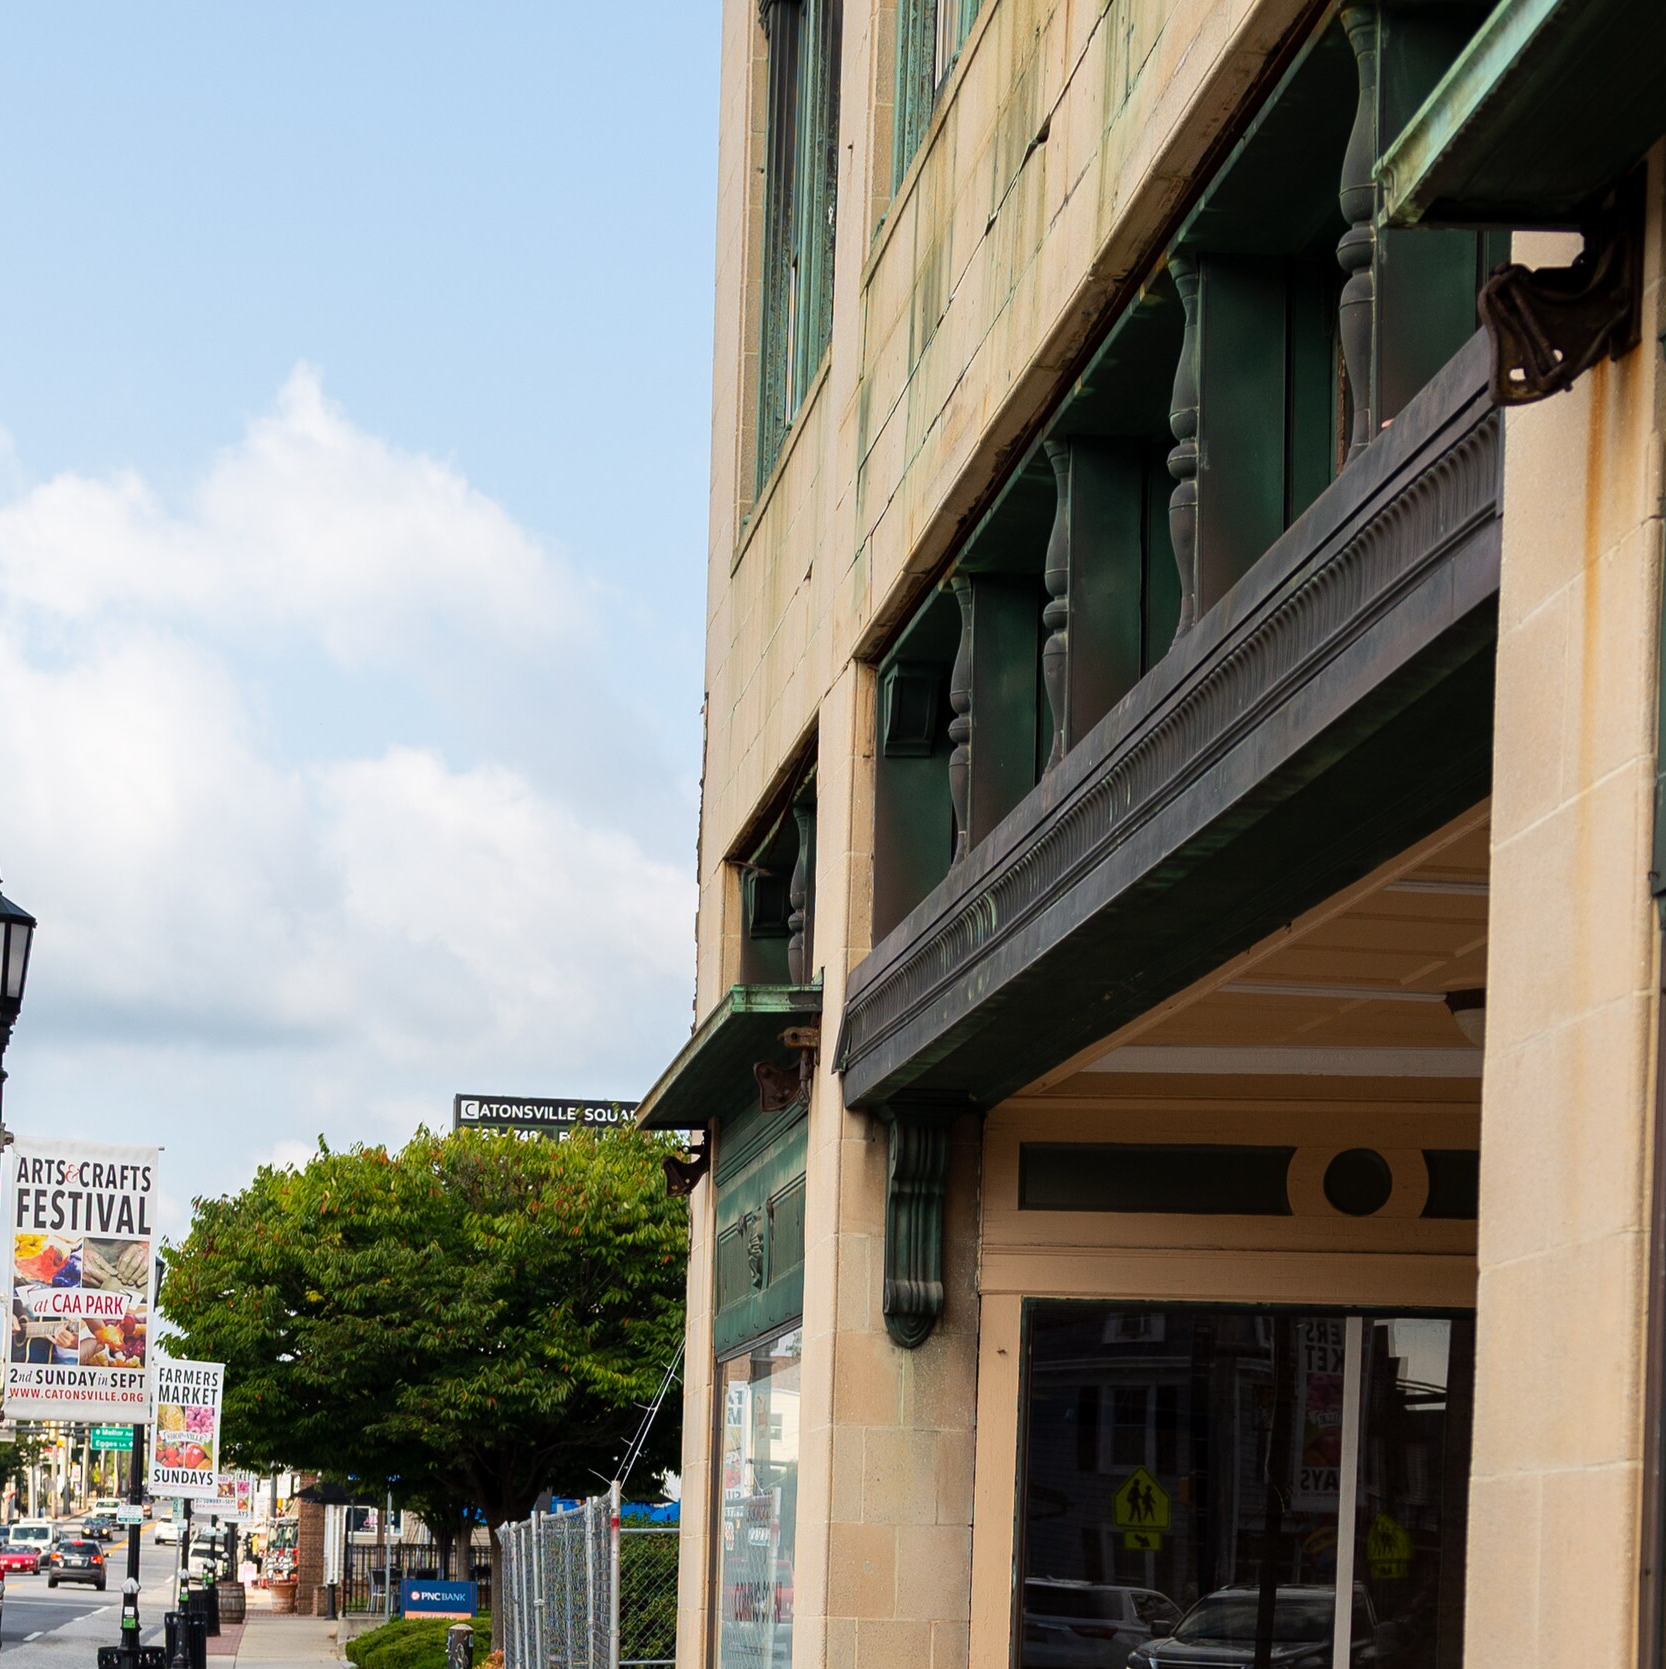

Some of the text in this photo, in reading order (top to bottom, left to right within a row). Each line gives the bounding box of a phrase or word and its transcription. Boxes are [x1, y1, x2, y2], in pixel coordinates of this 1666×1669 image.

[464, 1102, 576, 1121] CATONSVILLE
[16, 1188, 152, 1235] FESTIVAL
[33, 1293, 123, 1315] at CAA PARK
[10, 1368, 145, 1389] 2nd SUNDAY in SEPT
[159, 1367, 219, 1387] FARMERS
[9, 1388, 144, 1402] WWW.CATONSVILLE.ORG
[158, 1384, 218, 1406] MARKET
[153, 1468, 214, 1486] SUNDAYS
